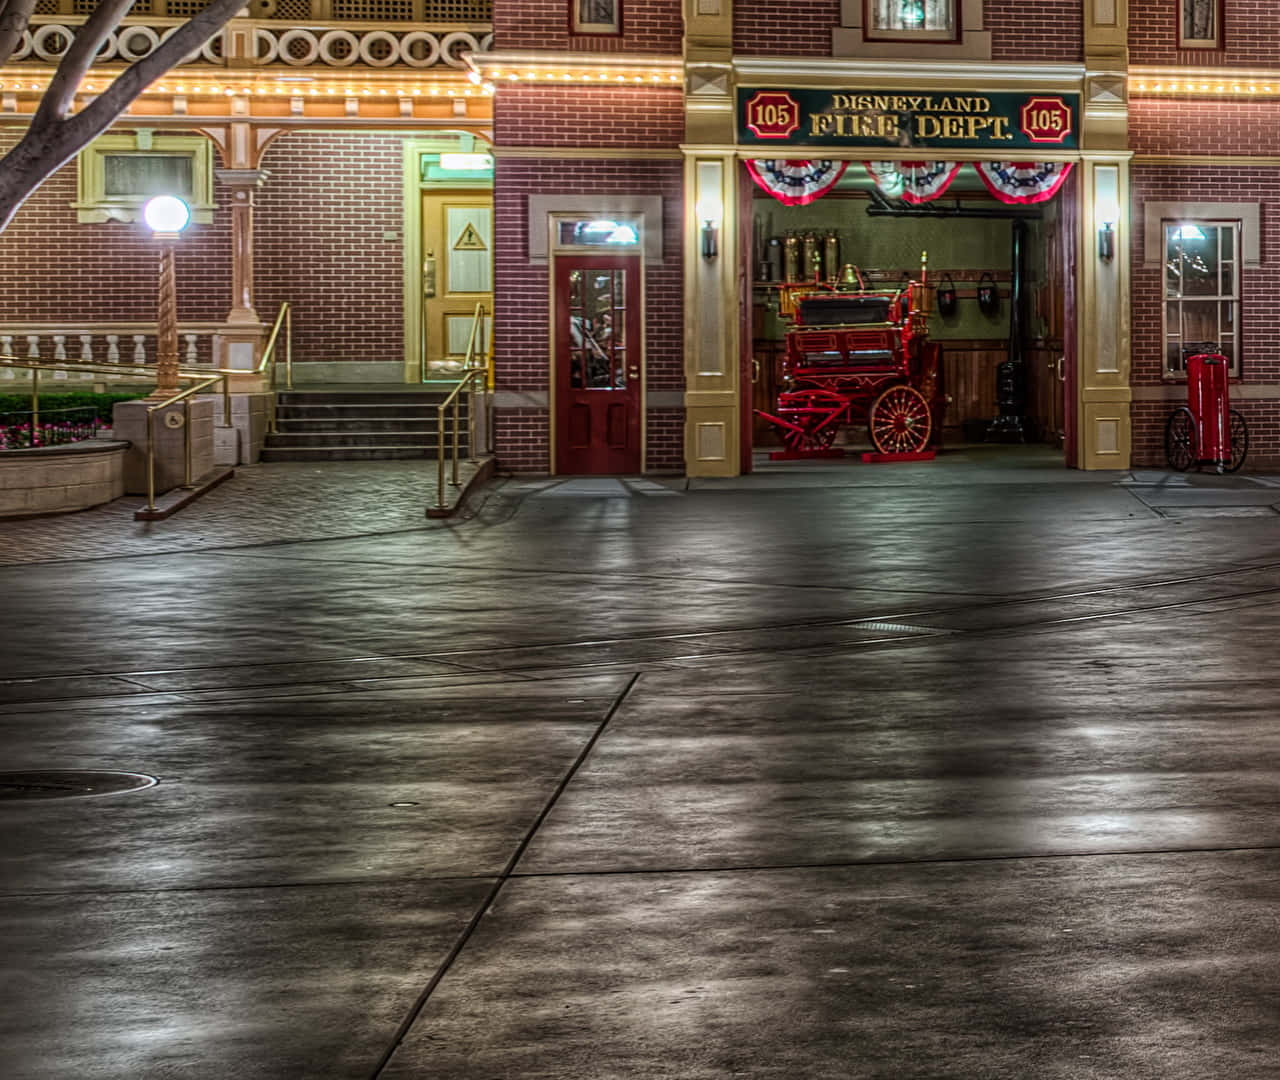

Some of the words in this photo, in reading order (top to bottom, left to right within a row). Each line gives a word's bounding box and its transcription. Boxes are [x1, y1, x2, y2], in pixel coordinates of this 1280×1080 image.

[832, 94, 990, 113] DISNEYLAND
[755, 104, 790, 127] 105
[1030, 108, 1063, 130] 105
[808, 113, 900, 138] FIRE
[914, 114, 1014, 141] DEPT.
